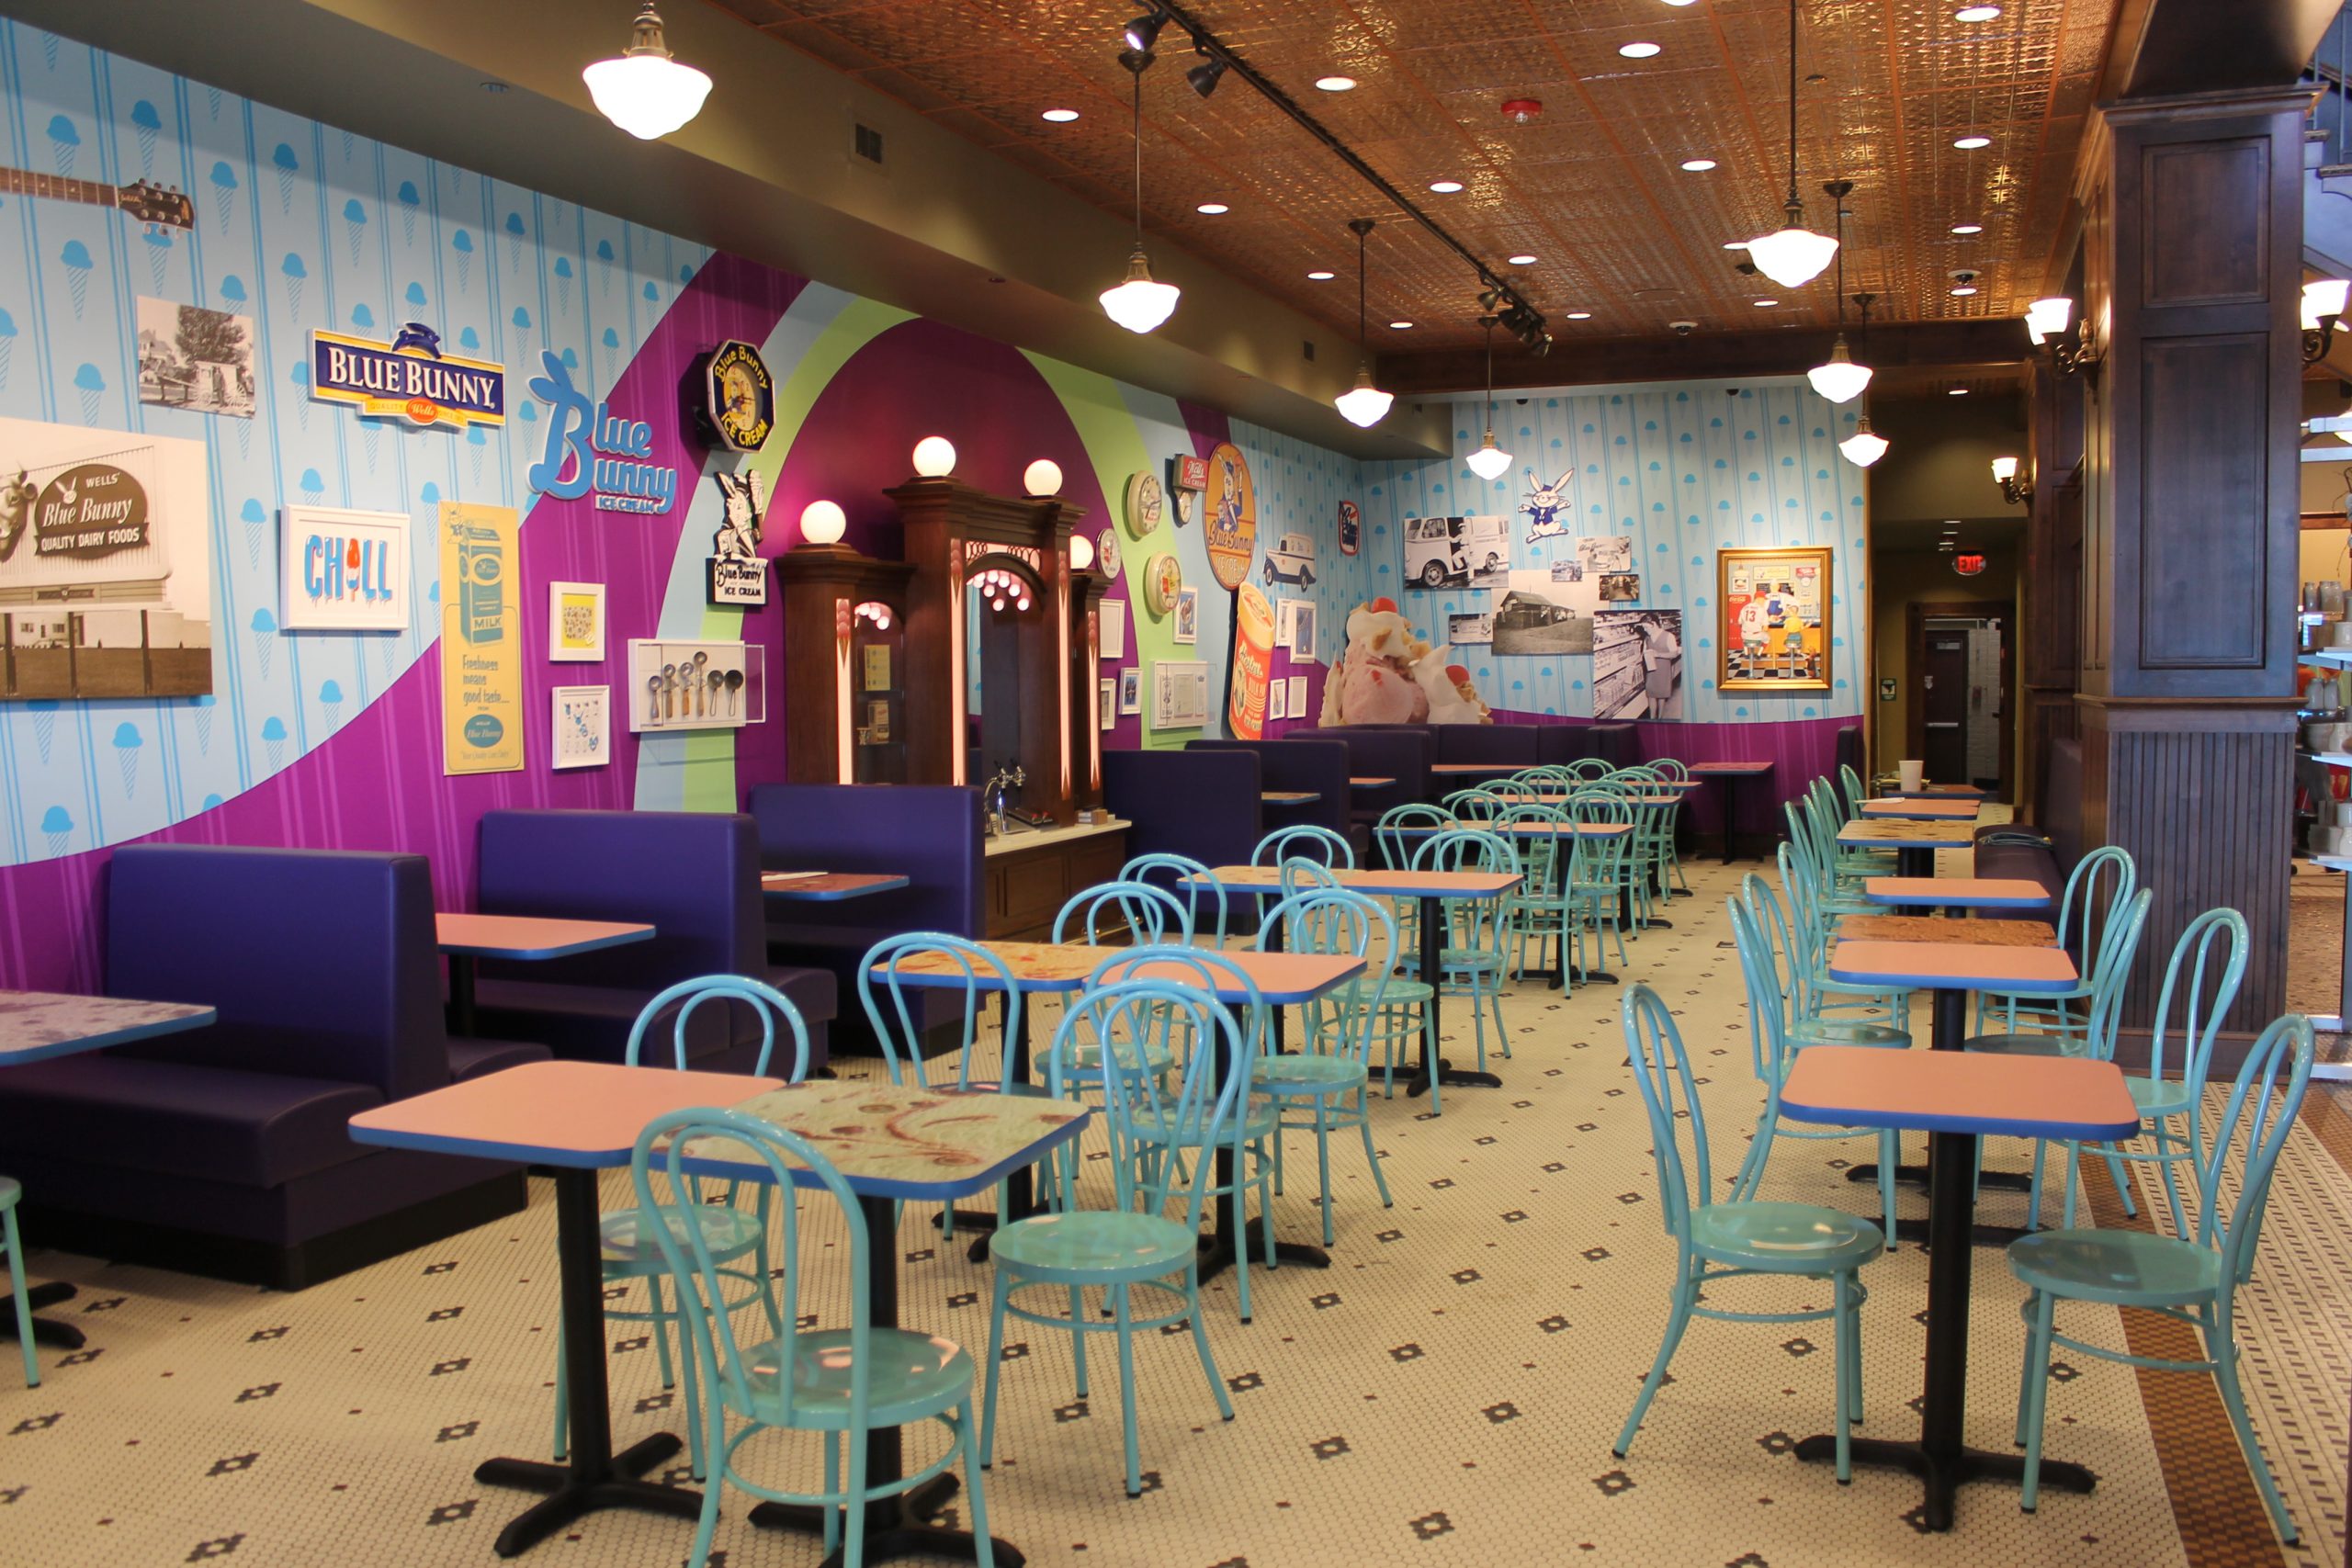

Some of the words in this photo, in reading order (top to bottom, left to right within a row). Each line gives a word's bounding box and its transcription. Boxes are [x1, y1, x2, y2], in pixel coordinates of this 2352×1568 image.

[328, 347, 401, 392] BLUE
[715, 350, 737, 382] Blue
[739, 346, 768, 389] Bunny
[411, 403, 435, 416] Wells
[720, 412, 738, 438] ICE
[738, 419, 768, 446] CREAM
[42, 502, 76, 527] Blue
[80, 498, 132, 525] Bunny
[599, 496, 616, 509] ICE
[618, 499, 654, 513] CREAM
[41, 535, 75, 551] QUALITY
[78, 531, 106, 547] DAIRY
[108, 527, 140, 545] FOODS
[1958, 555, 1983, 572] EXIT
[717, 562, 737, 587] Blue
[738, 564, 762, 584] Bunny
[724, 586, 736, 596] ICE
[739, 587, 762, 596] CREAM
[474, 616, 502, 628] MILK
[1745, 609, 1757, 622] 13
[463, 688, 482, 706] good
